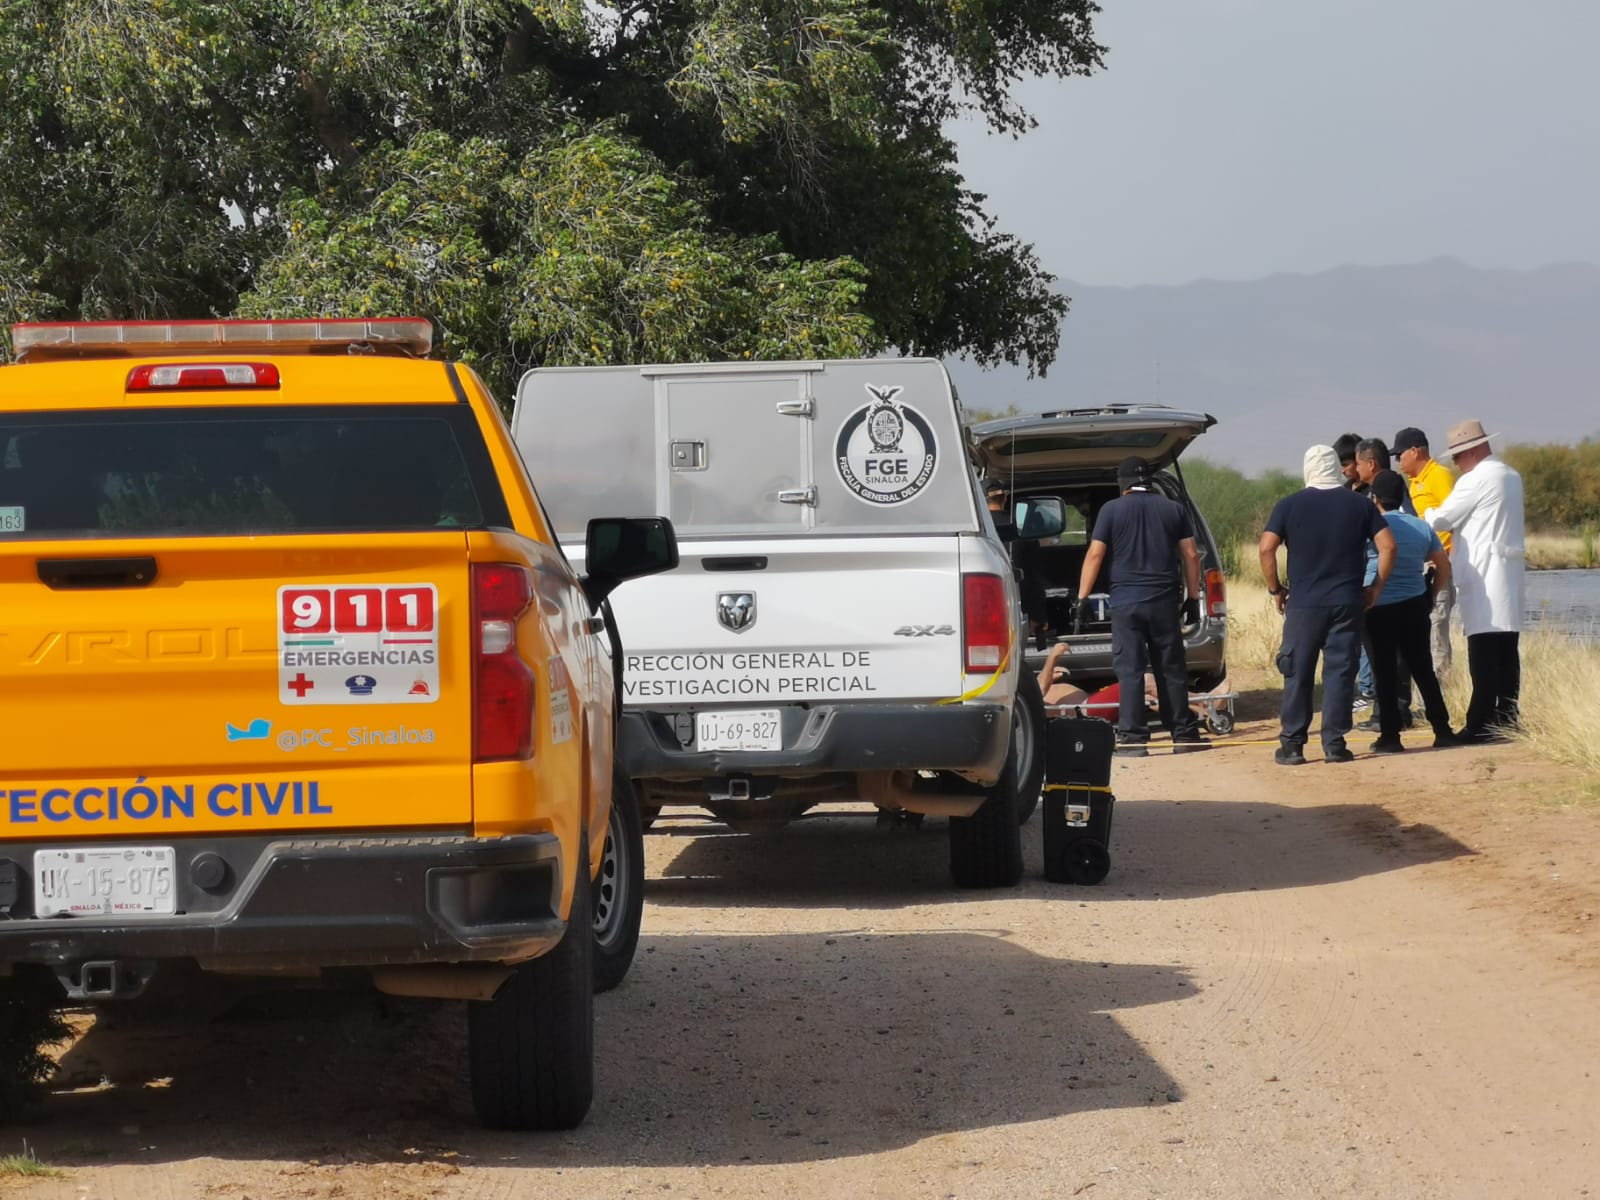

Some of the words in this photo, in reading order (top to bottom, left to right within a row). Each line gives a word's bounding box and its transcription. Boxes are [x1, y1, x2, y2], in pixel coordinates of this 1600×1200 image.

[860, 489, 901, 502] GENERAL
[901, 484, 919, 498] DEL
[915, 454, 934, 487] ESTADO
[865, 459, 908, 476] FGE
[865, 476, 909, 484] SINALOA
[292, 593, 418, 629] 911
[284, 650, 434, 667] EMERGENCIAS
[621, 651, 724, 671] RECCIÓN
[732, 652, 834, 669] GENERAL
[842, 651, 871, 667] DE
[622, 675, 769, 696] VESTIGACIÓN
[778, 676, 876, 693] PERICIAL
[277, 725, 435, 753] @PC_Sinaloa
[701, 721, 777, 741] UJ-69-827
[0, 775, 194, 823] ECCIÓN
[207, 781, 333, 817] CIVIL
[41, 866, 169, 898] UK-15-875
